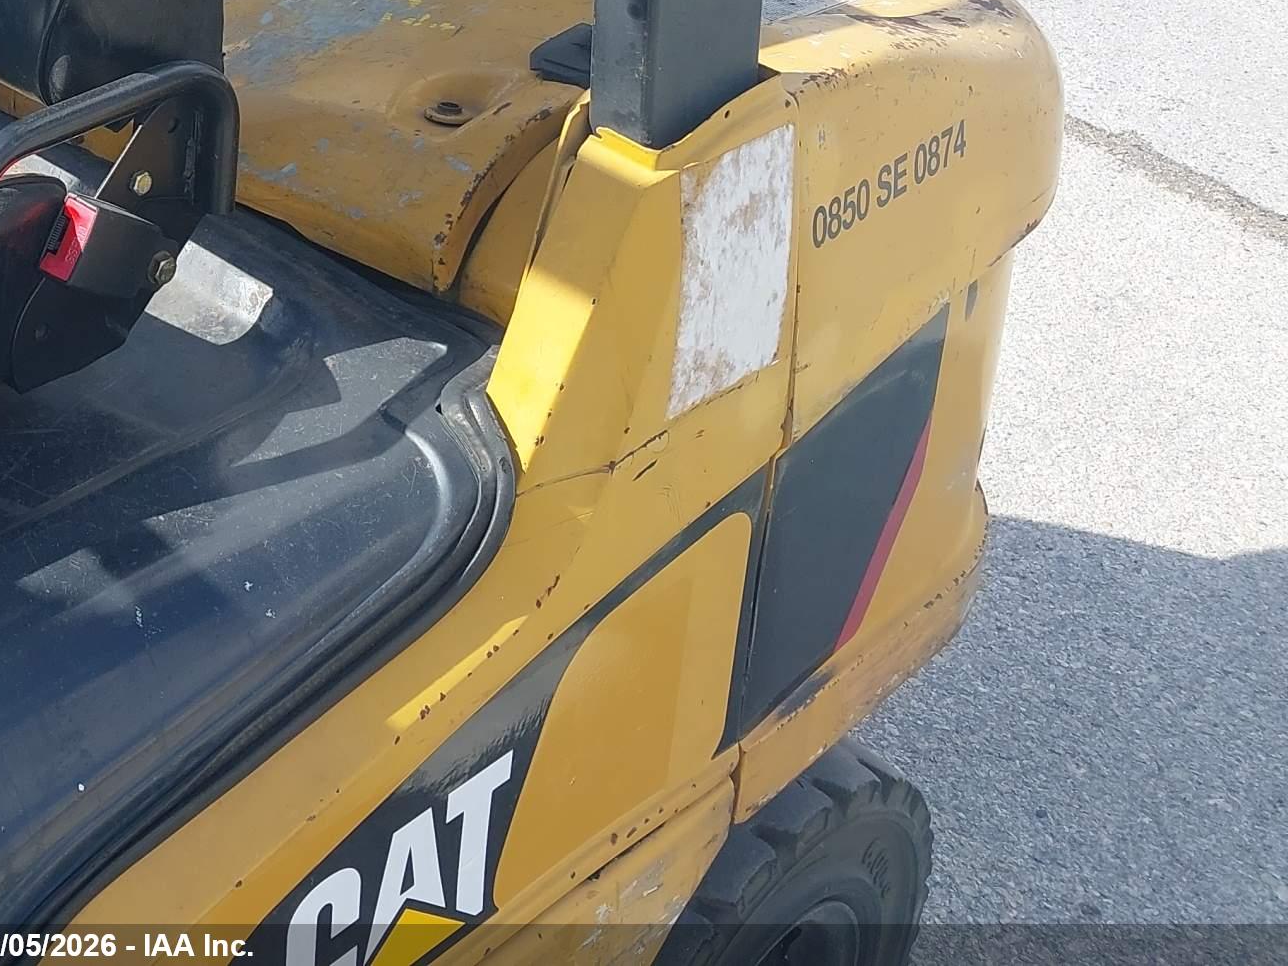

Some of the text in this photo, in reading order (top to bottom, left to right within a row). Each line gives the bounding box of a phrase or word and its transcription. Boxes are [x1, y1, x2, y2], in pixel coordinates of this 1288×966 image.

[812, 120, 967, 248] 0850 SE 0874
[286, 749, 514, 966] CAT
